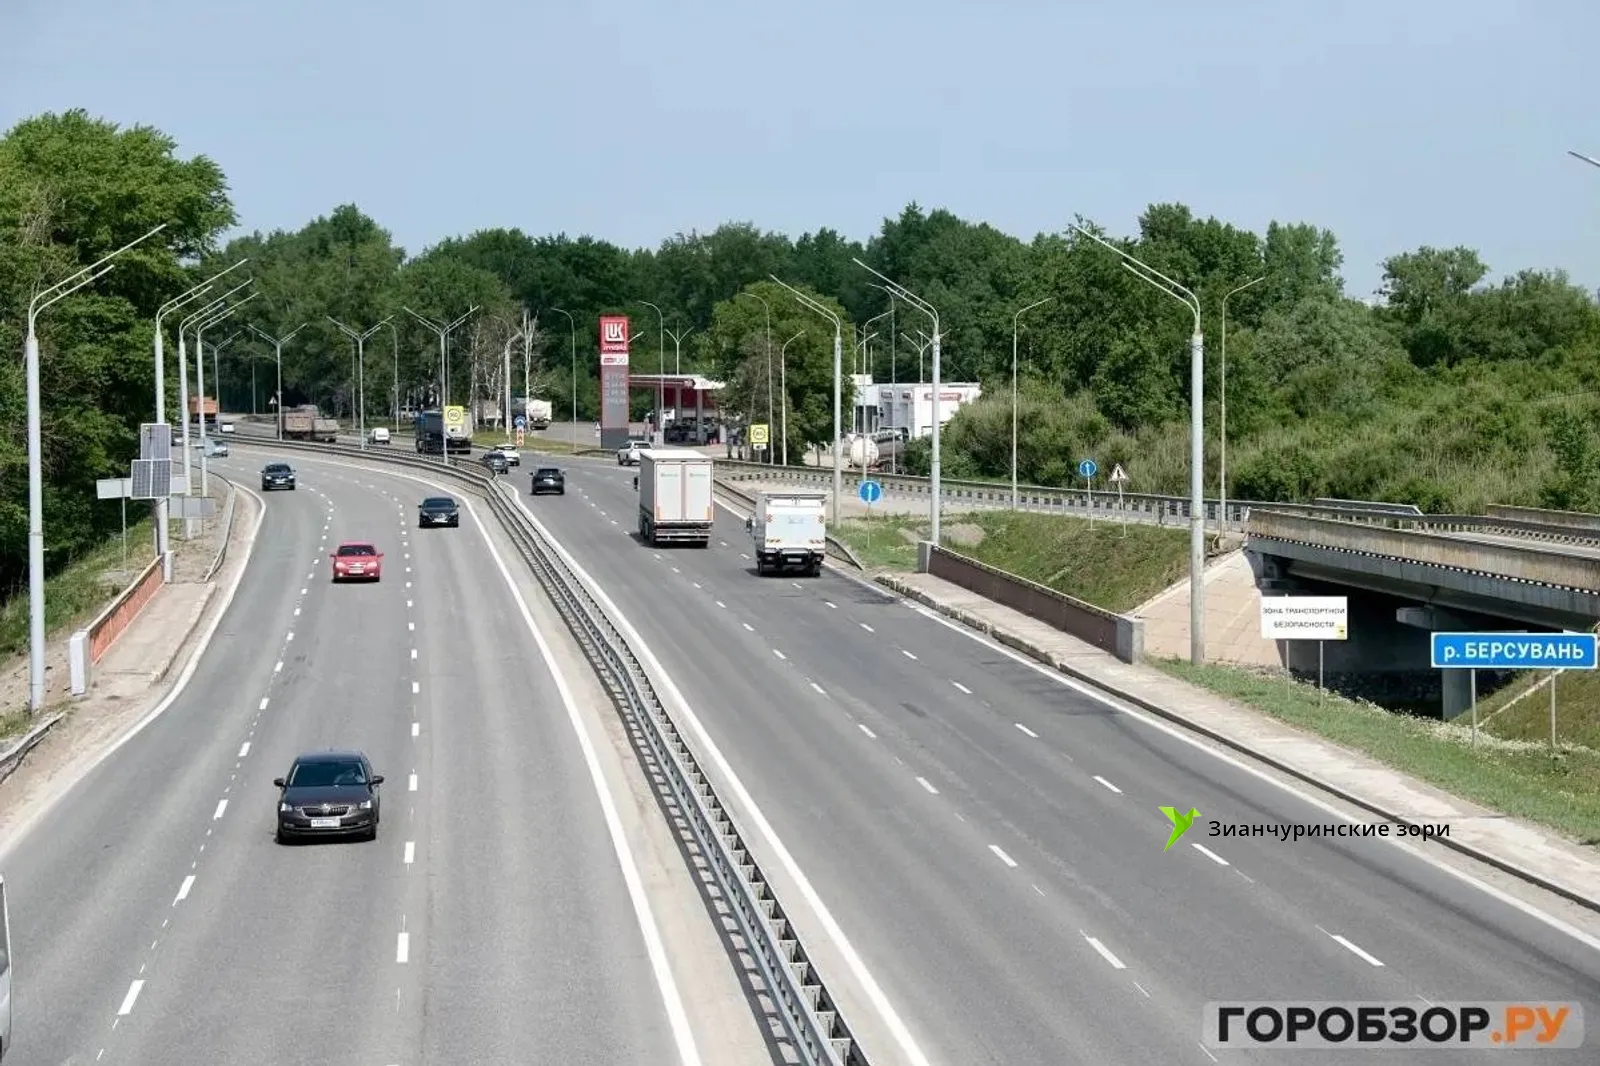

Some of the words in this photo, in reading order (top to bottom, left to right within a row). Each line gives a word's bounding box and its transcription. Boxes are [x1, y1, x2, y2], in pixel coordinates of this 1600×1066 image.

[1263, 606, 1284, 614] ЗОНА
[1273, 621, 1335, 629] БЕЗОПАСНОСТИ
[1444, 645, 1461, 662] р.
[1465, 642, 1584, 659] БЕРСУВАНЬ
